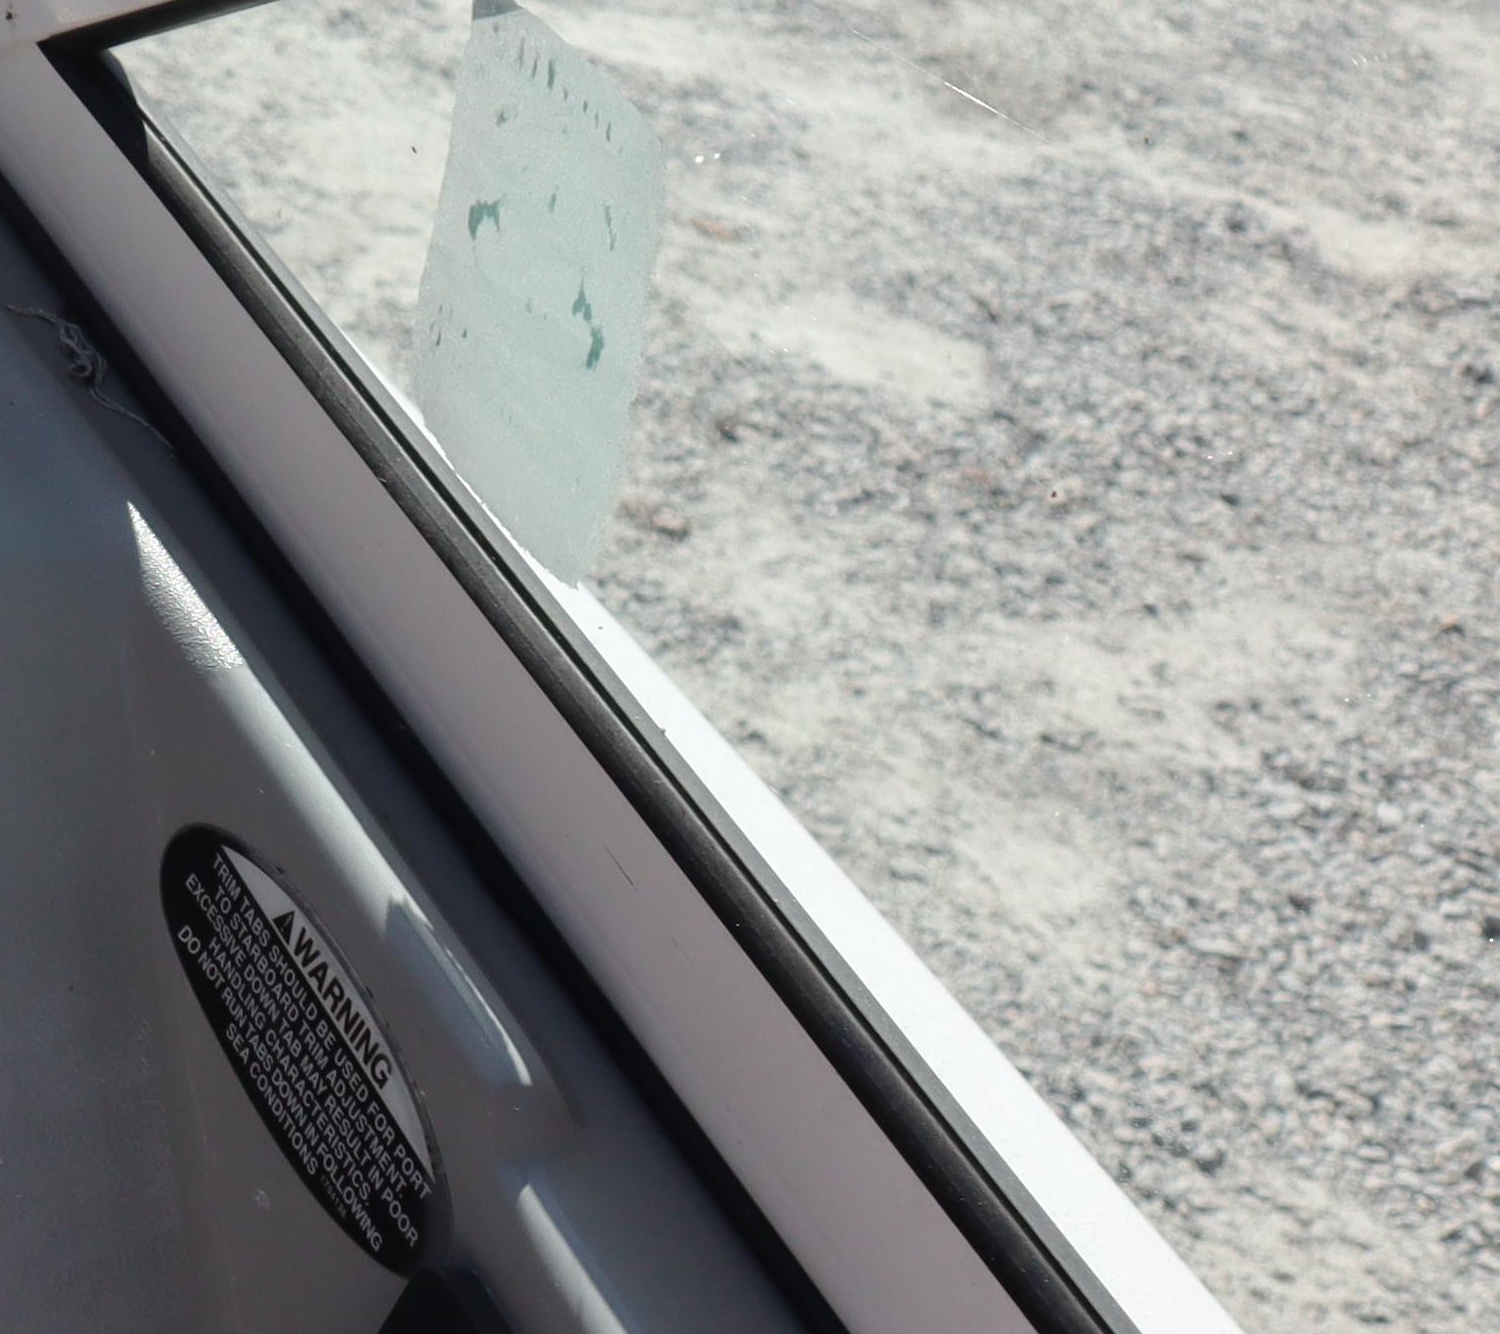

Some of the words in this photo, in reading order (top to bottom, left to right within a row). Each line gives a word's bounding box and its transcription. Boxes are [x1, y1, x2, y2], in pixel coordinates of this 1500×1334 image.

[178, 925, 201, 954] DO
[198, 951, 225, 988] NOT
[186, 874, 246, 966] EXCESSIVE
[244, 964, 280, 1022] DOWN
[279, 1018, 301, 1057] TAB
[300, 1055, 327, 1095] MAY
[325, 1098, 371, 1165] RESULT
[368, 1165, 384, 1190] IN
[381, 1187, 418, 1246] POOR
[214, 853, 241, 900] TRIM
[241, 896, 270, 947] TABS
[269, 945, 317, 1020] SHOULD
[316, 1020, 336, 1050] BE
[335, 1048, 368, 1102] USED
[367, 1101, 395, 1145] FOR
[394, 1144, 431, 1198] PORT
[215, 885, 231, 914] TO
[231, 913, 298, 1021] STARBOARD
[299, 1020, 328, 1069] TRIM
[321, 1070, 406, 1197] ADJUSTMENT.
[222, 987, 247, 1027] RUN
[246, 1022, 273, 1071] TABS
[284, 927, 391, 1089] WARNING
[209, 937, 265, 1030] HANDLING
[255, 1029, 384, 1205] CHARACTERISTICS.
[226, 1023, 249, 1064] SEA
[250, 1062, 327, 1174] CONDITIONS
[272, 1068, 307, 1126] DOWN
[305, 1122, 319, 1146] IN
[309, 1142, 382, 1251] FOLLOWING
